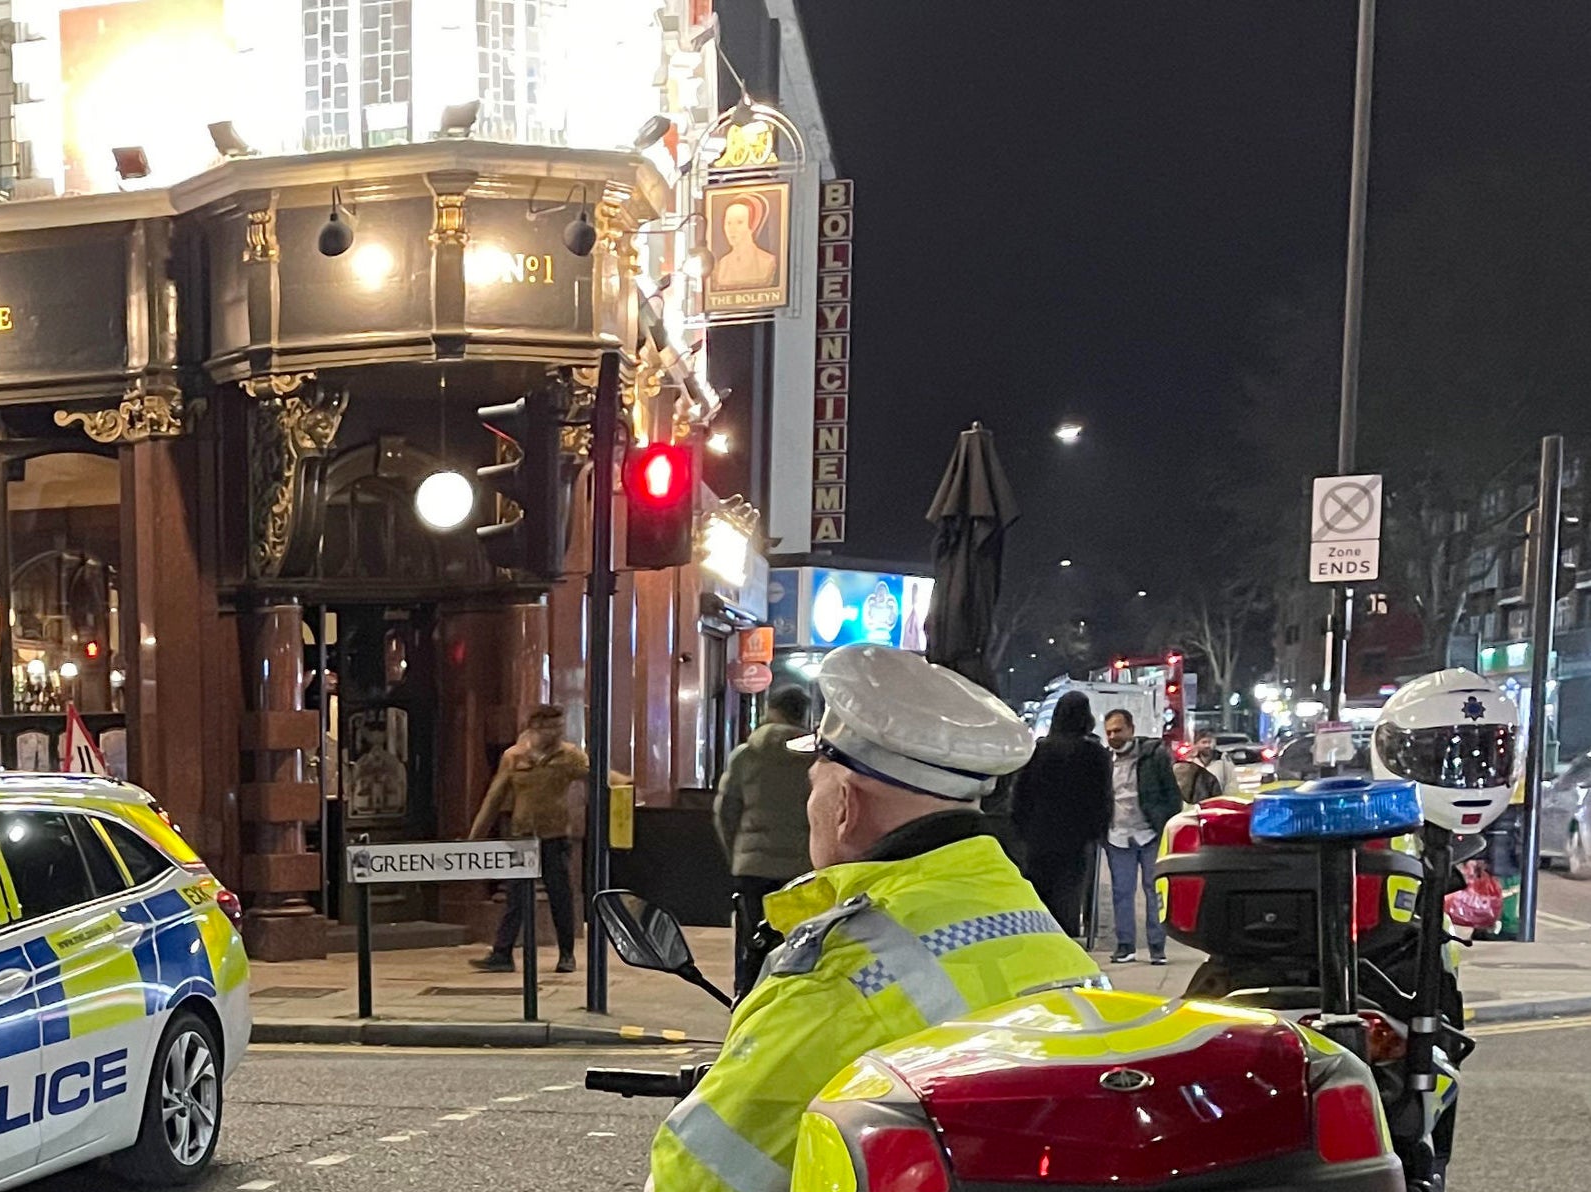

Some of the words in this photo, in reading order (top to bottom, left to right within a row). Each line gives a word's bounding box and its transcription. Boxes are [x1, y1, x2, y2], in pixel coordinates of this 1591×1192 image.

[710, 295, 733, 306] THE
[735, 291, 780, 304] BOLEYN
[1328, 546, 1362, 558] Zone
[1318, 560, 1371, 576] ENDS
[370, 852, 435, 873] GREEN
